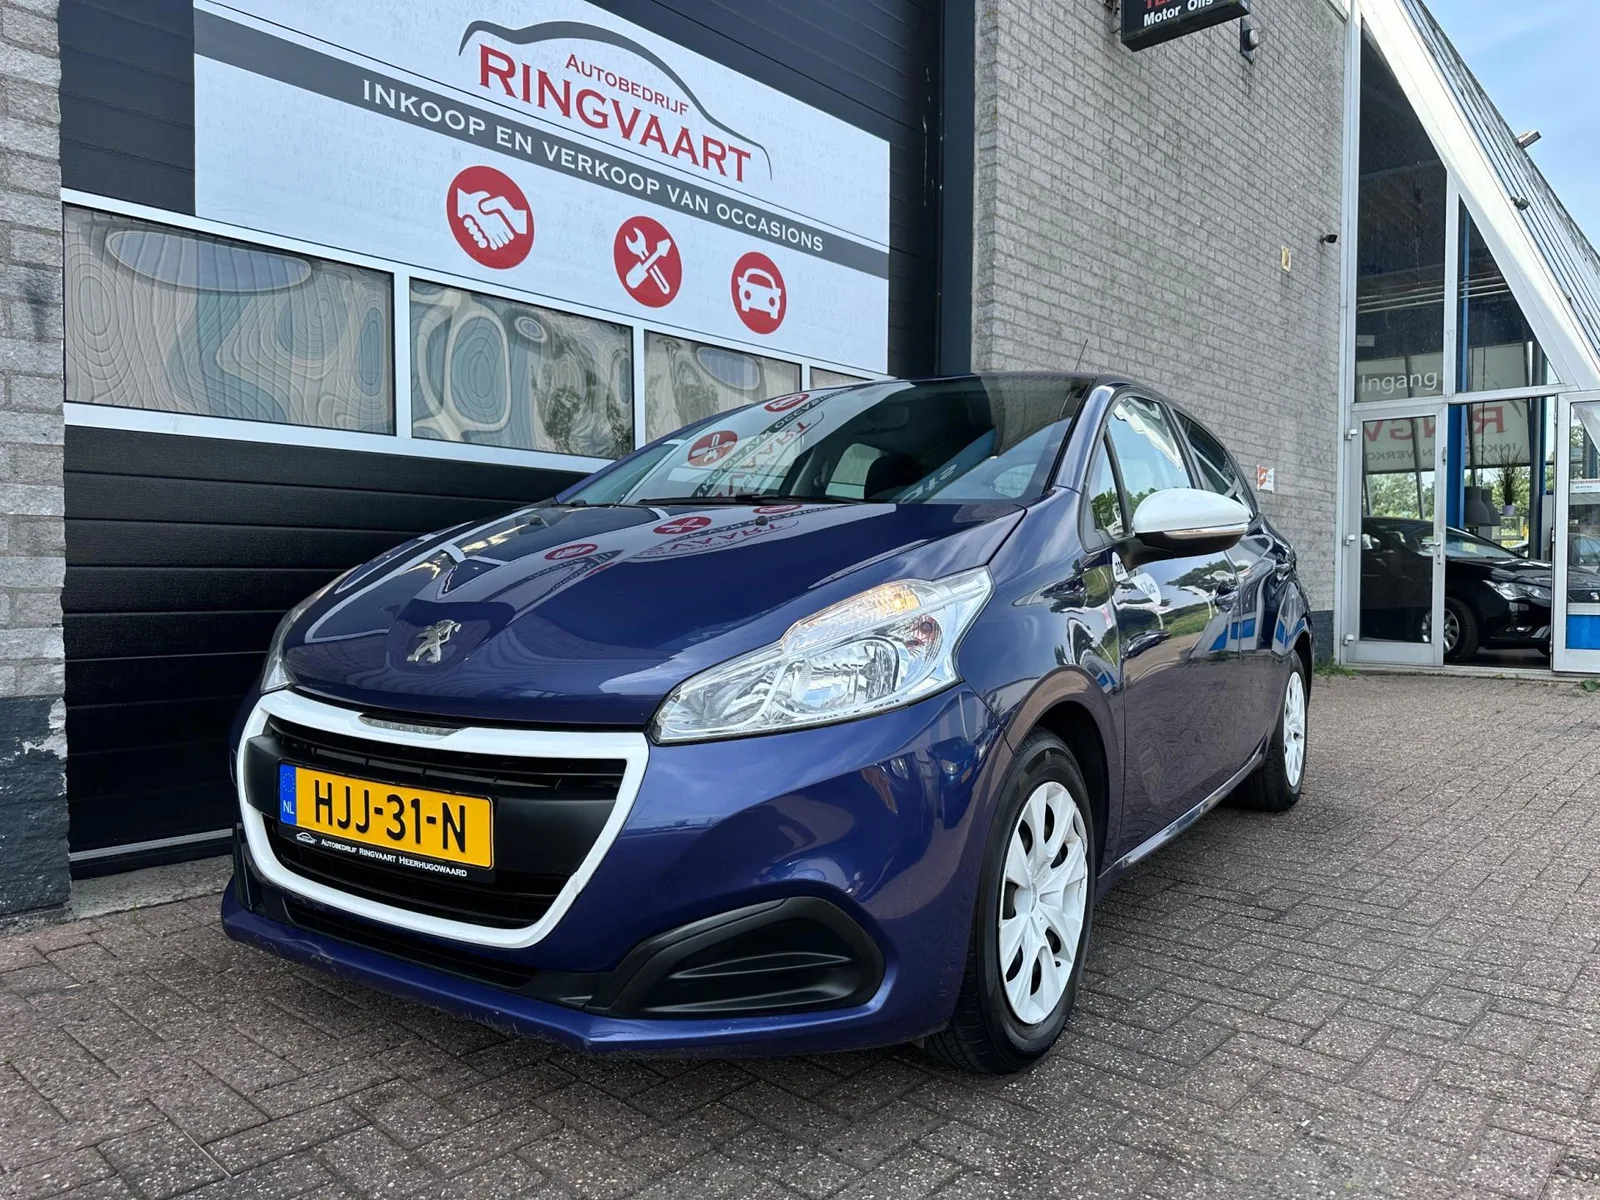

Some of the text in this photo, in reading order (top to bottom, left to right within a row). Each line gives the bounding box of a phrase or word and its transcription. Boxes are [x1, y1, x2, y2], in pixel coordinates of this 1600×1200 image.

[1143, 5, 1181, 27] Motor
[1187, 0, 1214, 11] Oils
[565, 53, 690, 117] AUTOBEDRIJF
[478, 43, 752, 183] RINGVAART
[362, 79, 824, 252] INKOOP EN VERKOOP VAN OCCASIONS
[1361, 371, 1438, 395] Ingang
[283, 800, 295, 815] NL
[314, 779, 466, 853] HJJ-31-N
[321, 838, 357, 853] AUTOBEDRIJF
[359, 848, 396, 863] RINGVAART
[399, 856, 467, 877] HEERHUGOWAARD
